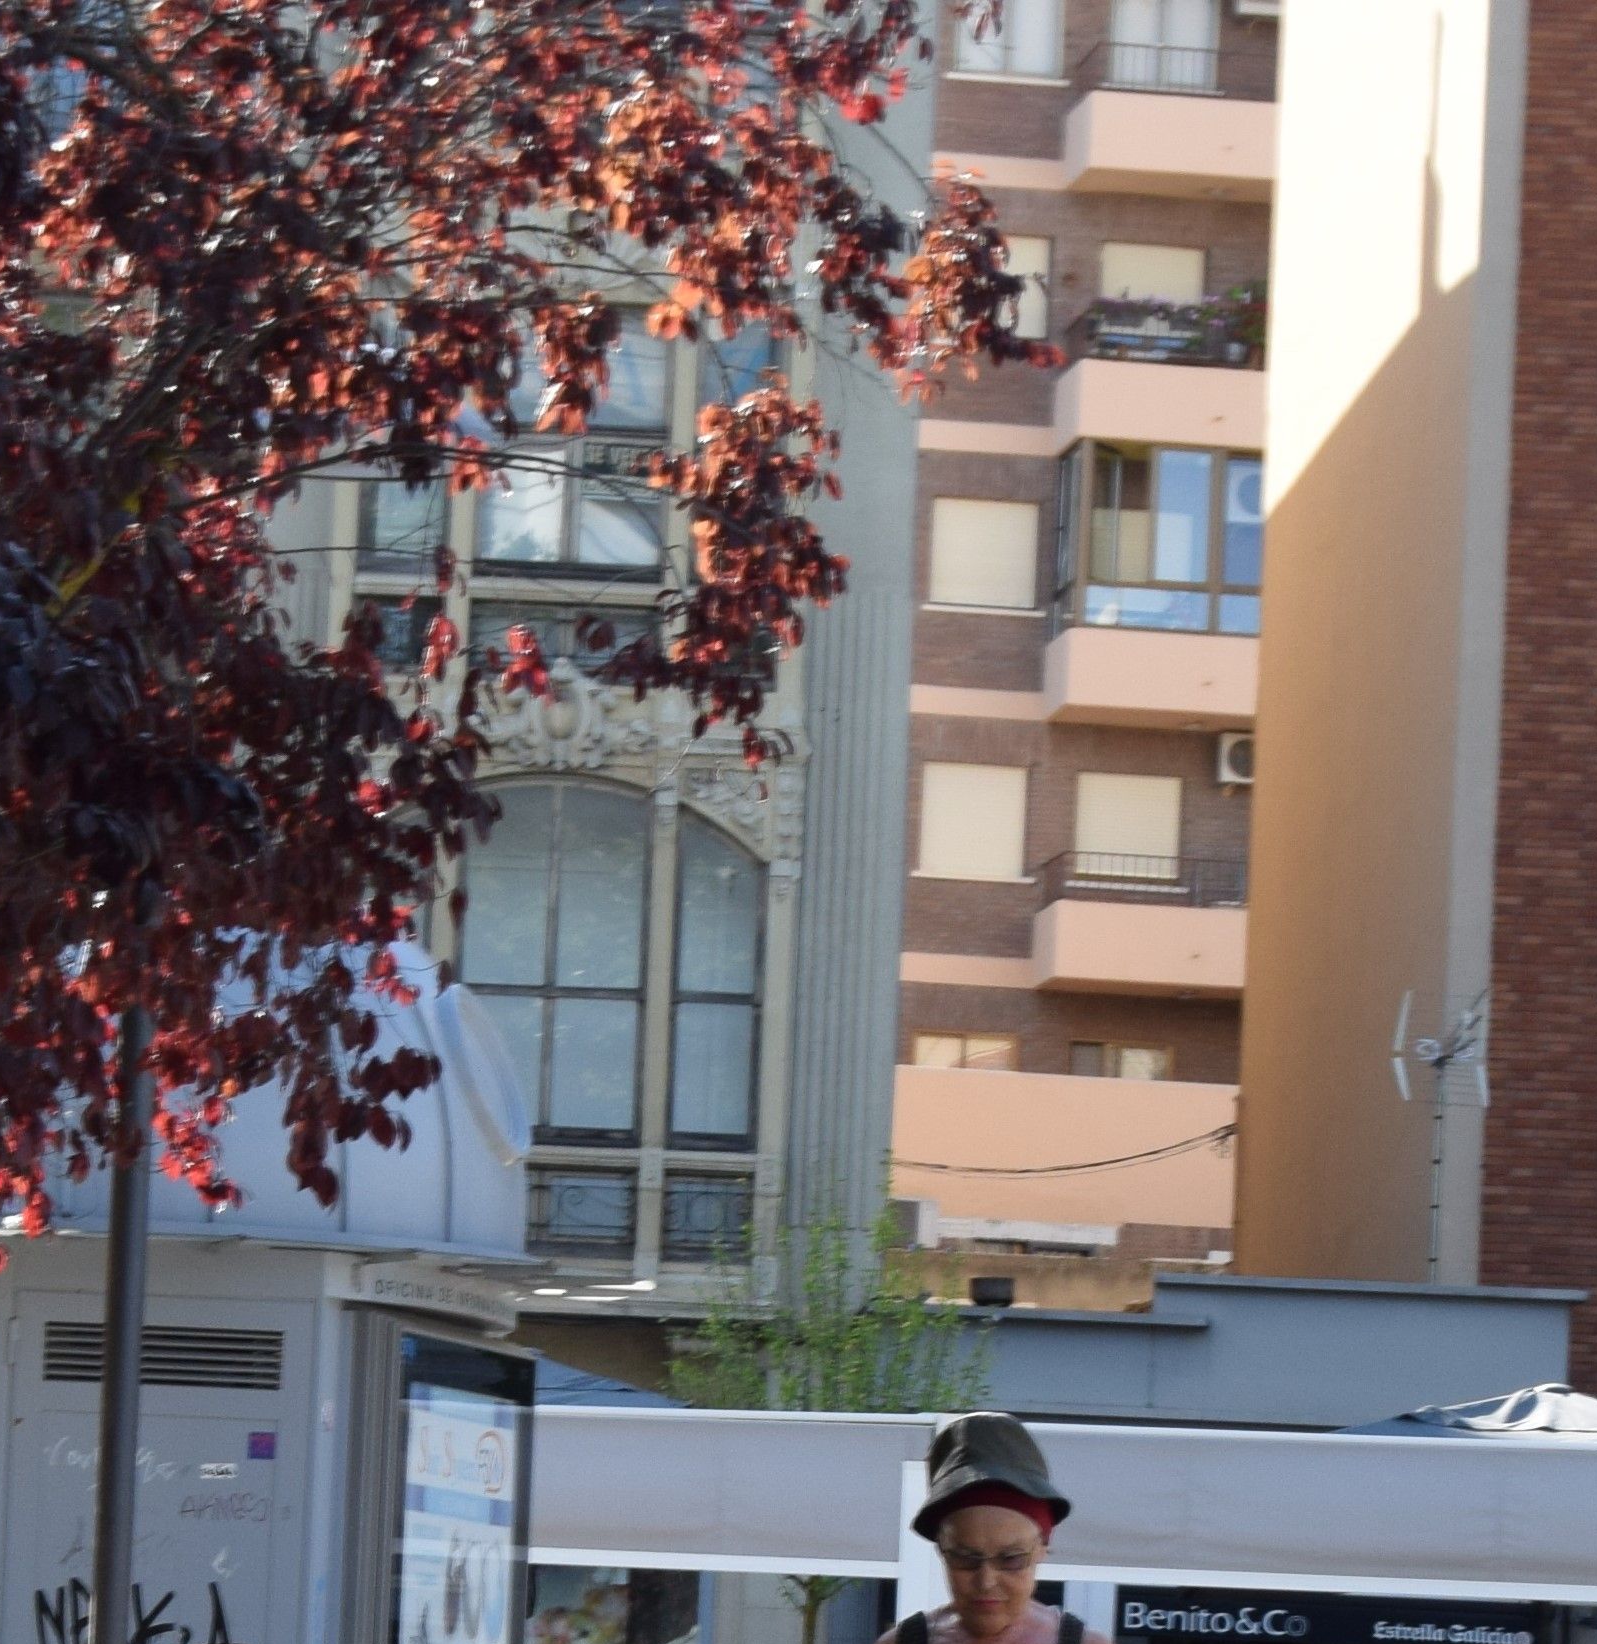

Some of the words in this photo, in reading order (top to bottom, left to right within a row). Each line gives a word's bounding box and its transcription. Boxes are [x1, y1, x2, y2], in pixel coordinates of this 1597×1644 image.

[374, 1278, 433, 1300] OFICINA
[1122, 1600, 1309, 1637] Benito&Co
[1372, 1620, 1446, 1642] Estrella
